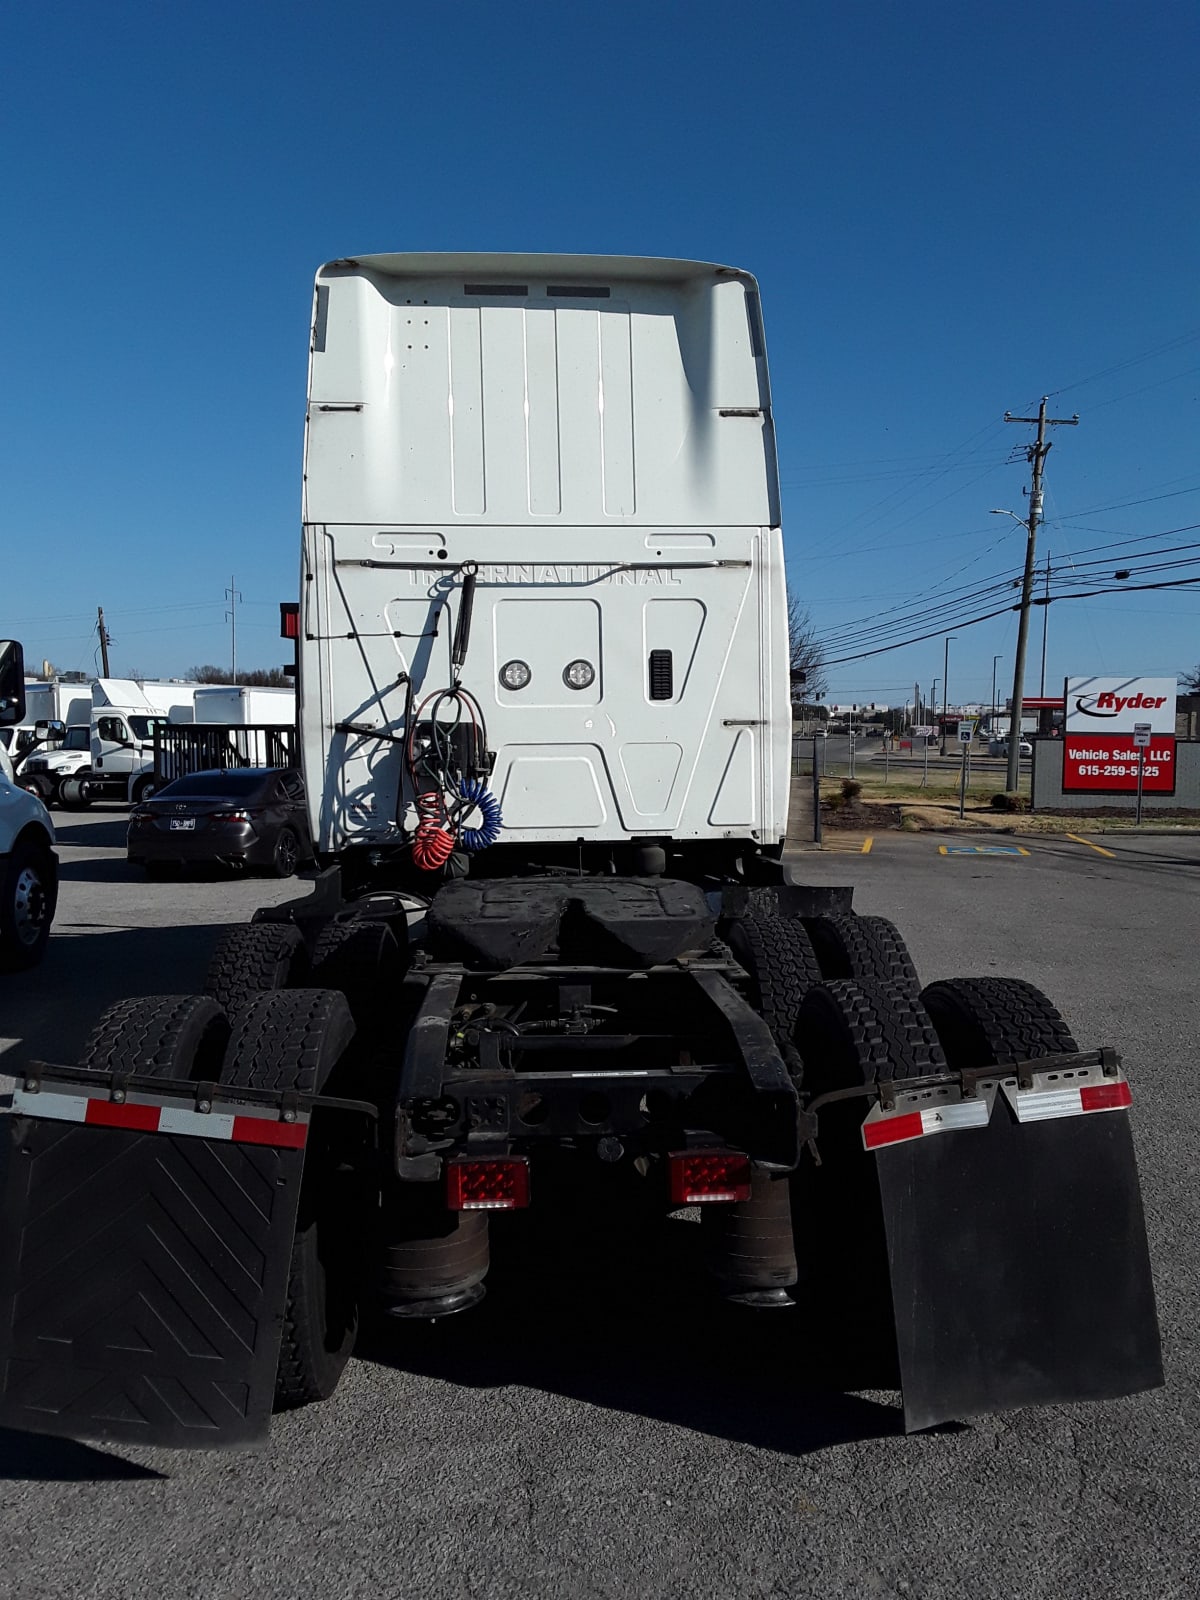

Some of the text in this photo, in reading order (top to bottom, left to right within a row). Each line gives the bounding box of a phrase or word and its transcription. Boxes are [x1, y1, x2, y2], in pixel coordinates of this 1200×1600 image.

[409, 565, 681, 586] INERNATIONAL
[1097, 692, 1167, 712] Ryder
[1069, 749, 1109, 760] Vehicle
[1150, 750, 1171, 761] LLC
